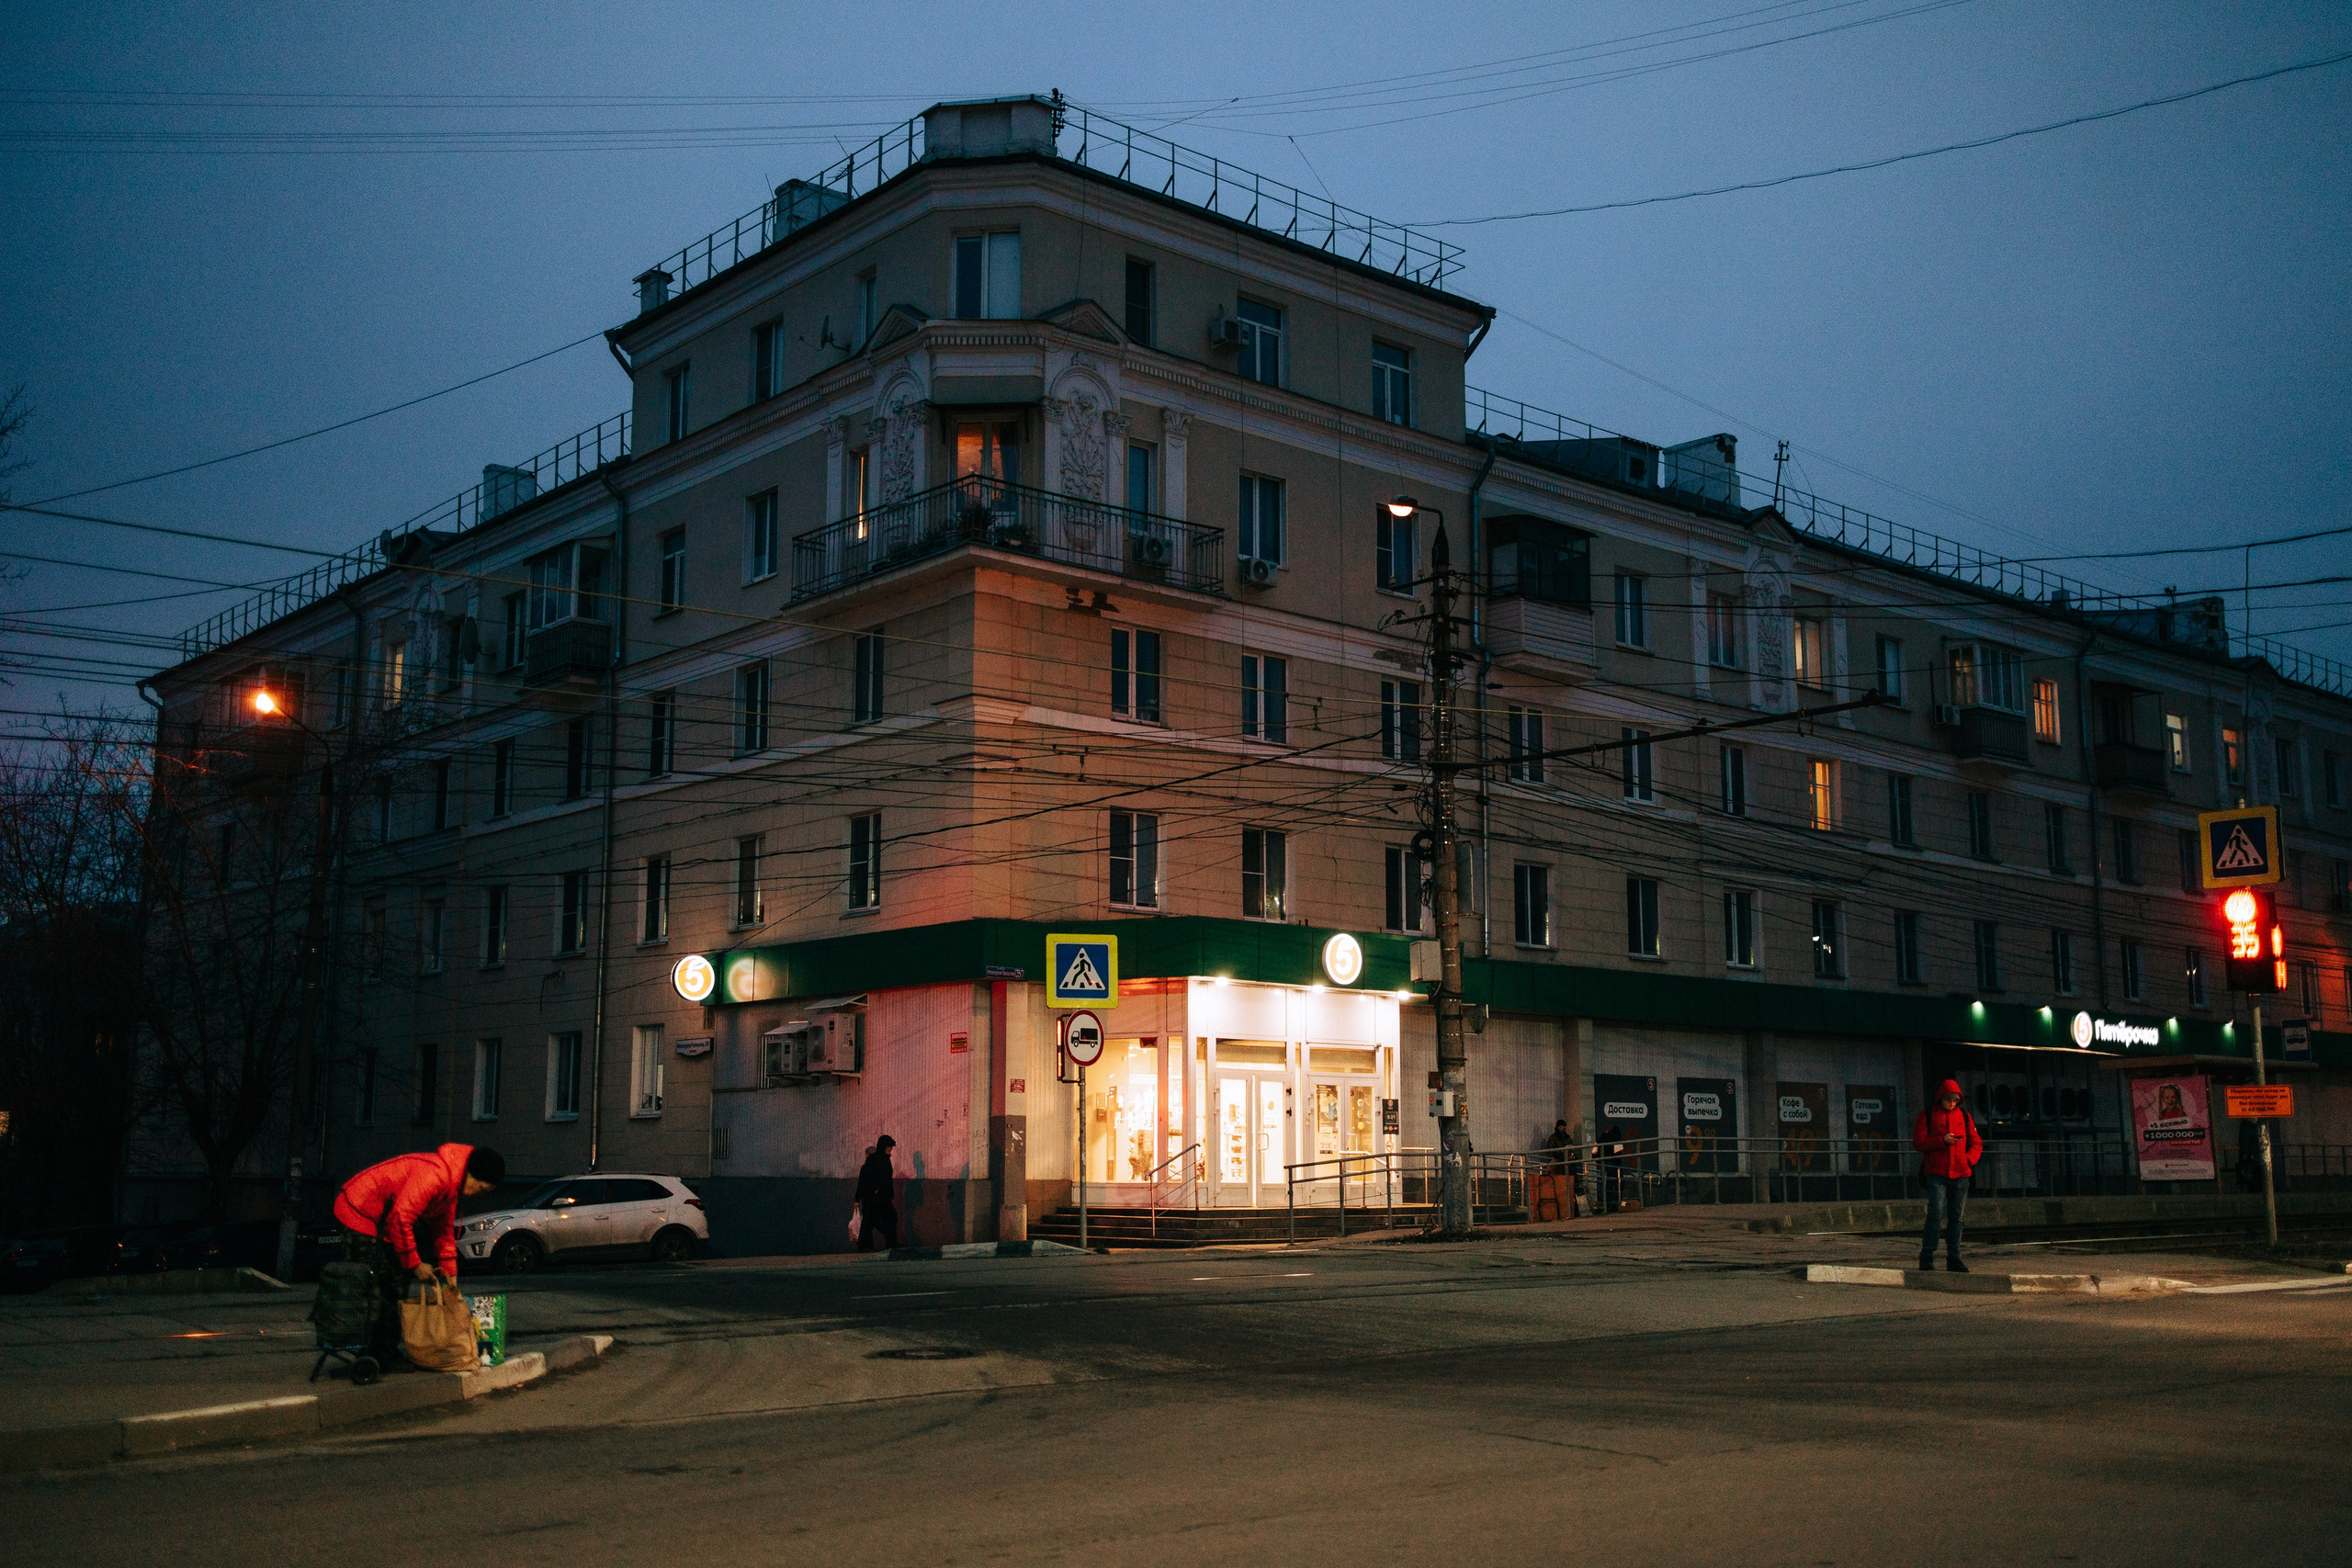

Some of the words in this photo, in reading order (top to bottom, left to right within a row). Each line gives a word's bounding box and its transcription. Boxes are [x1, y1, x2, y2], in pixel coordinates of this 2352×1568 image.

[2231, 922, 2260, 959] 35
[2095, 1019, 2159, 1048] Пятёрочка
[1687, 1095, 1715, 1106] Горячая
[1782, 1099, 1800, 1109] Кофе
[1855, 1100, 1880, 1110] Готовая
[1608, 1104, 1644, 1115] Доставка
[1688, 1108, 1719, 1116] выпечка
[1788, 1110, 1808, 1118] собой
[1856, 1112, 1868, 1121] еда
